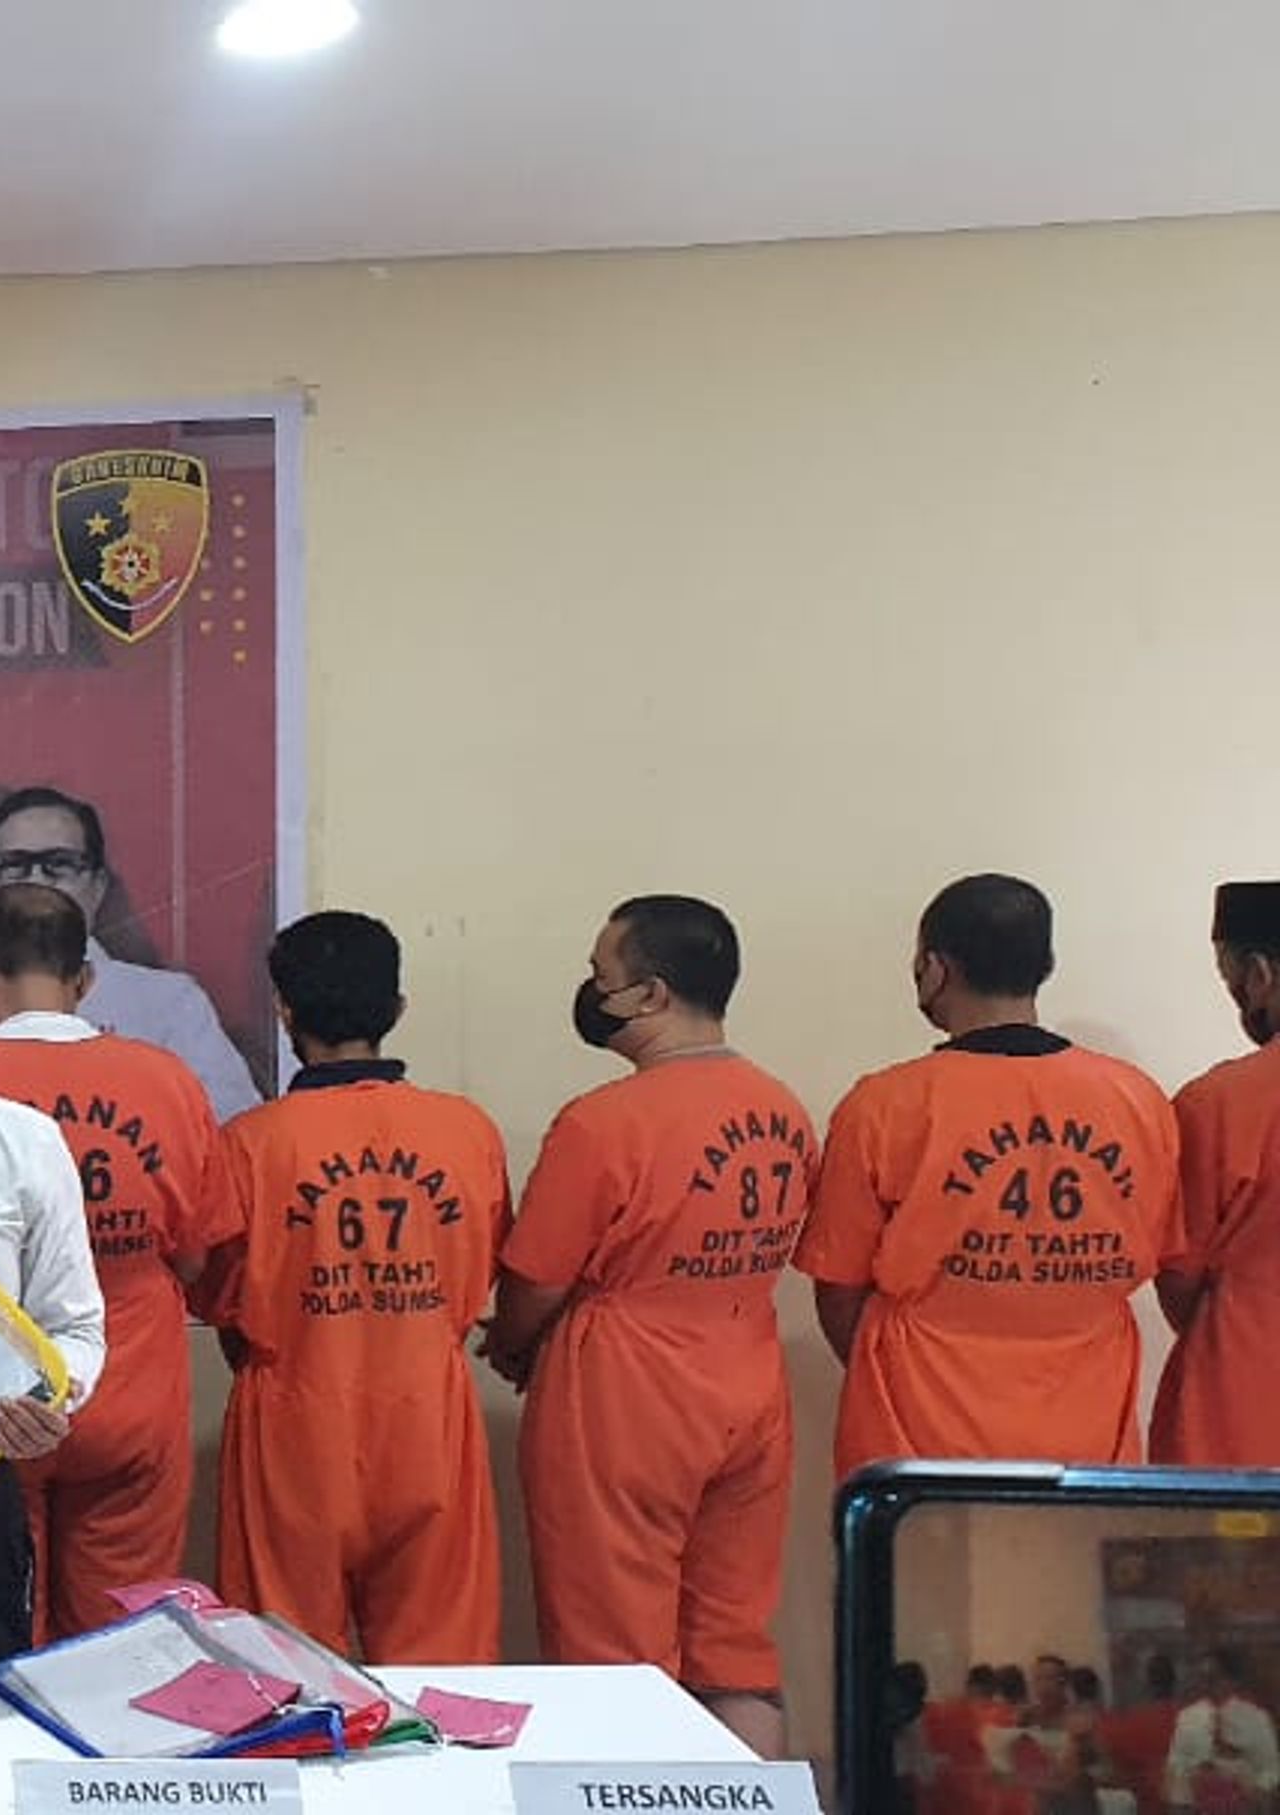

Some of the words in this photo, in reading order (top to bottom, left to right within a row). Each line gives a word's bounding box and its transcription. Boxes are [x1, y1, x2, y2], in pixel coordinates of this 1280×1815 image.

[52, 1093, 164, 1175] ANAN
[689, 1109, 806, 1195] TAHANA
[80, 1148, 113, 1202] 6
[286, 1146, 463, 1230] TAHANAN
[741, 1161, 793, 1220] 87
[997, 1166, 1083, 1222] 46
[337, 1197, 408, 1252] 67
[701, 1229, 745, 1252] DIT
[961, 1229, 1014, 1254] DIT
[1025, 1231, 1123, 1256] TAHTI
[311, 1263, 352, 1287] DIT
[943, 1254, 1022, 1283] OLDA
[68, 1781, 182, 1807] BARANG
[189, 1780, 267, 1807] BUKTI
[578, 1782, 775, 1812] TERSANGKA
